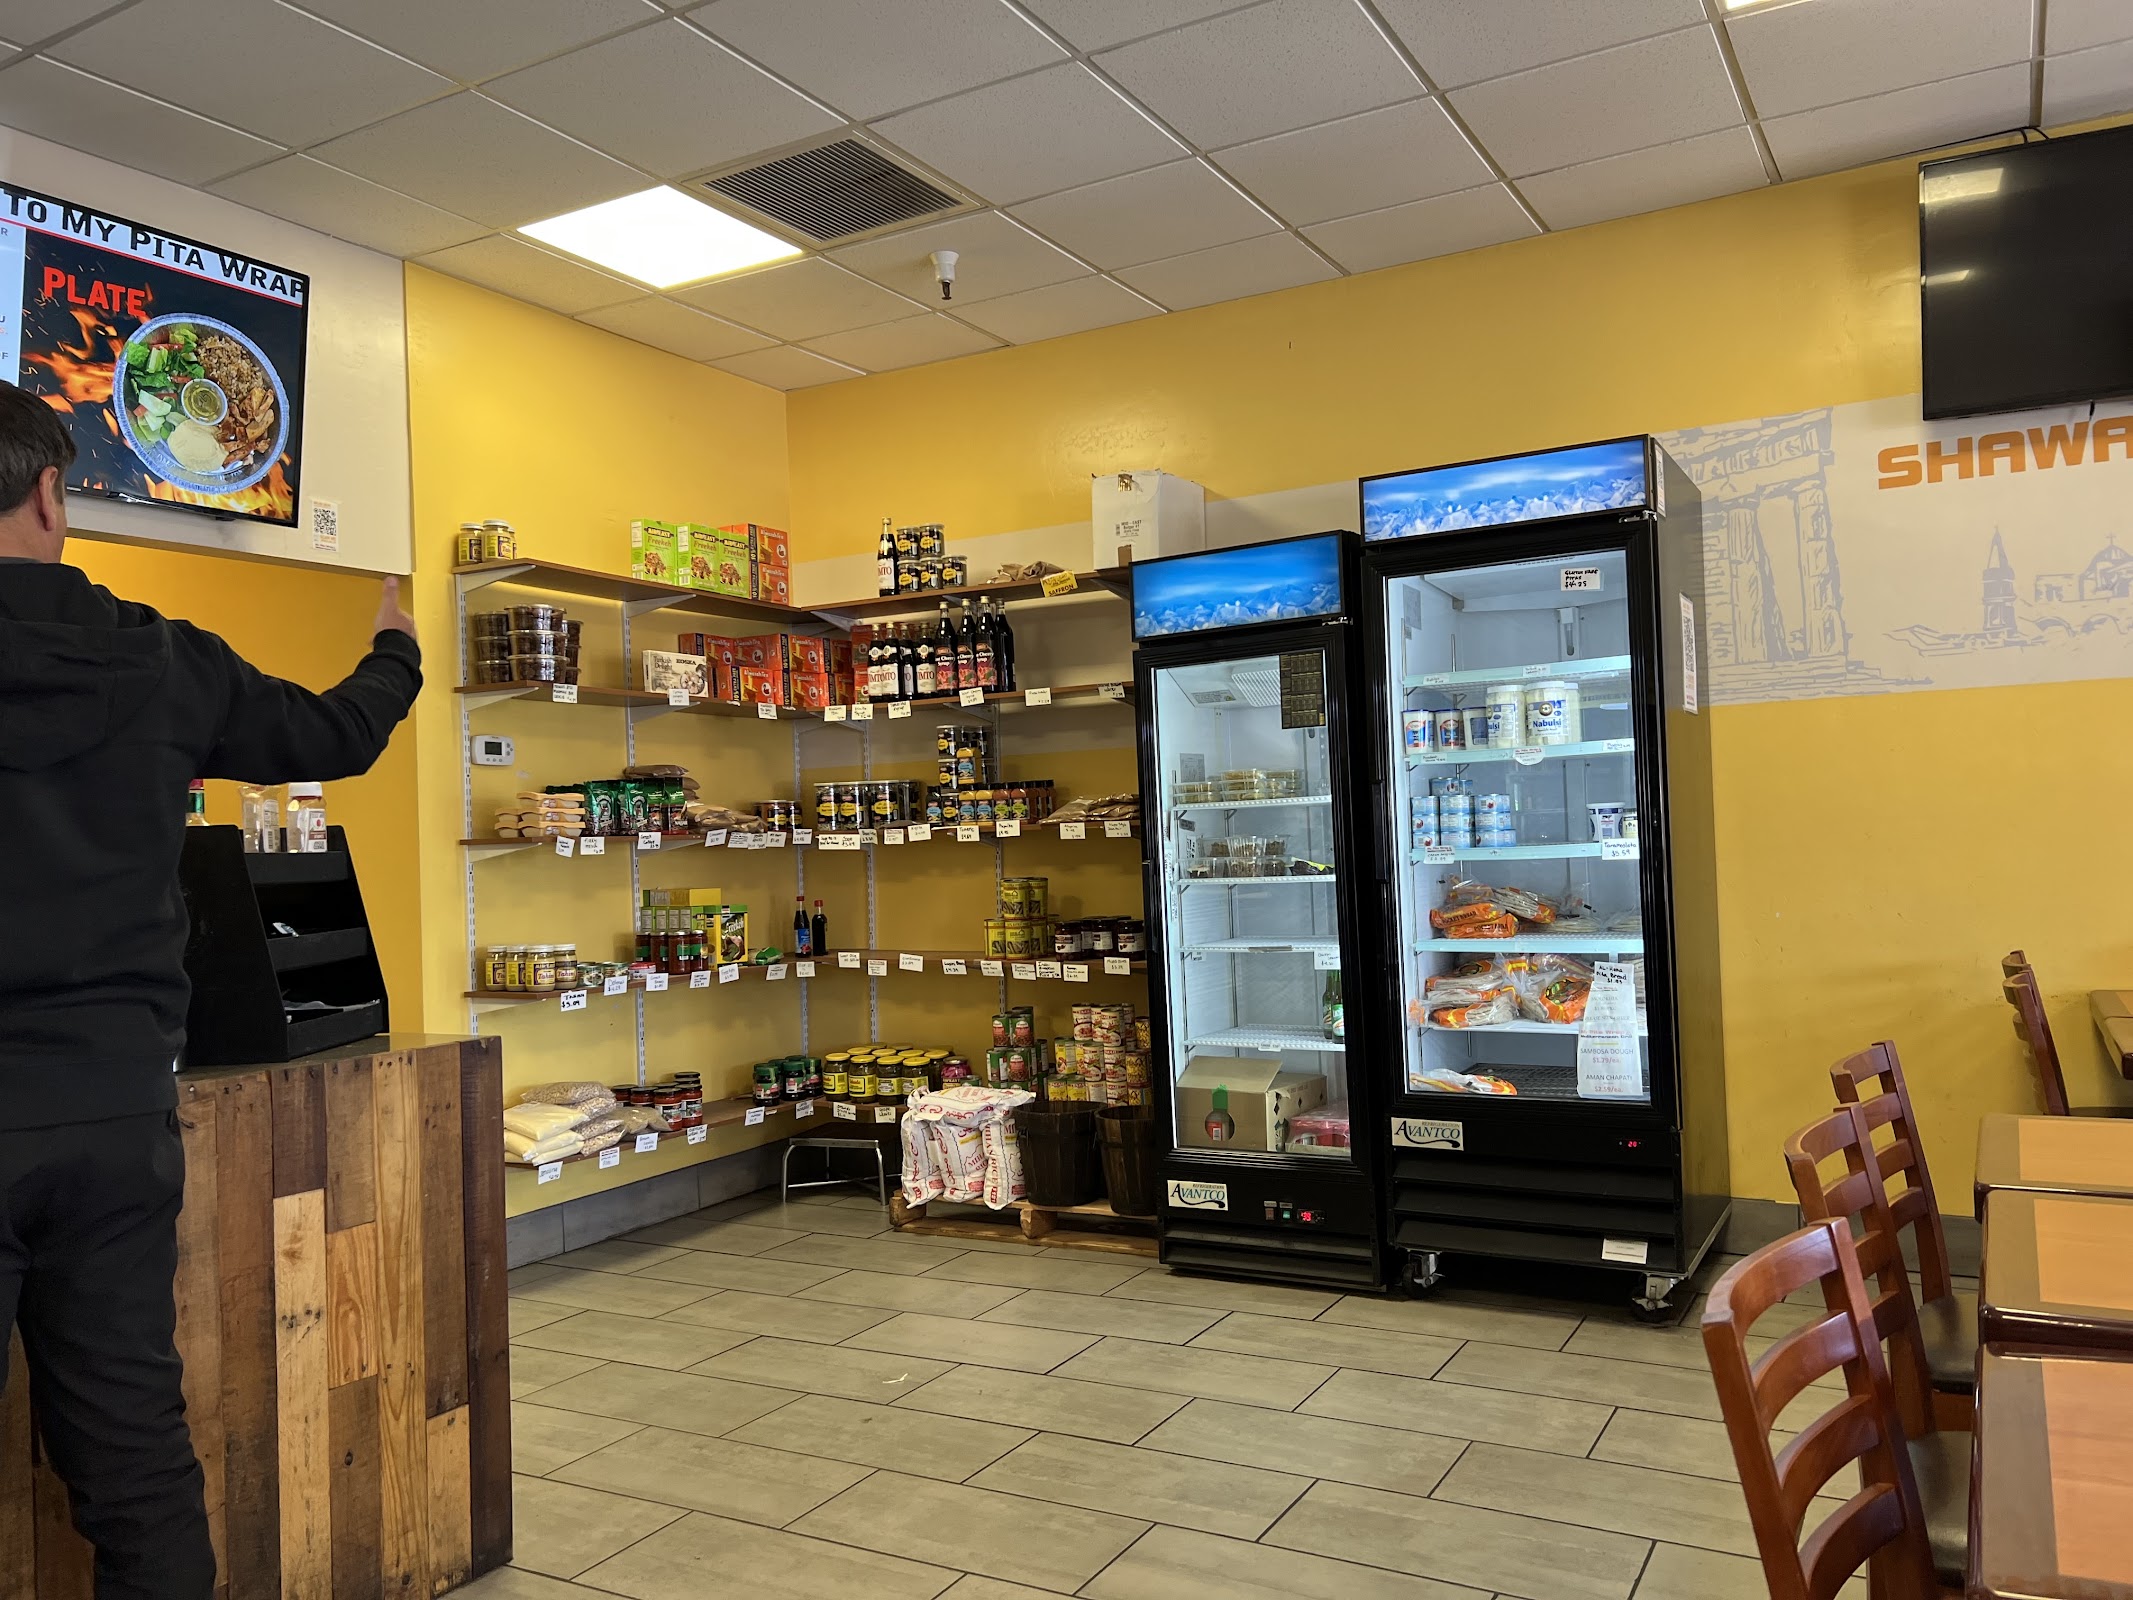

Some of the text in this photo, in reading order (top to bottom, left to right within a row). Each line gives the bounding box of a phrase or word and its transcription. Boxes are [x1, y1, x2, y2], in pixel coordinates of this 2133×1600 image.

[3, 189, 303, 298] TO MY PITA WRAP
[44, 266, 147, 318] PLATE
[1878, 416, 2133, 490] SHAWA
[1532, 719, 1562, 730] Nabulsi
[1394, 1120, 1461, 1140] AVANTCO
[991, 1158, 999, 1184] RICE
[1170, 1183, 1226, 1201] AVANTCO
